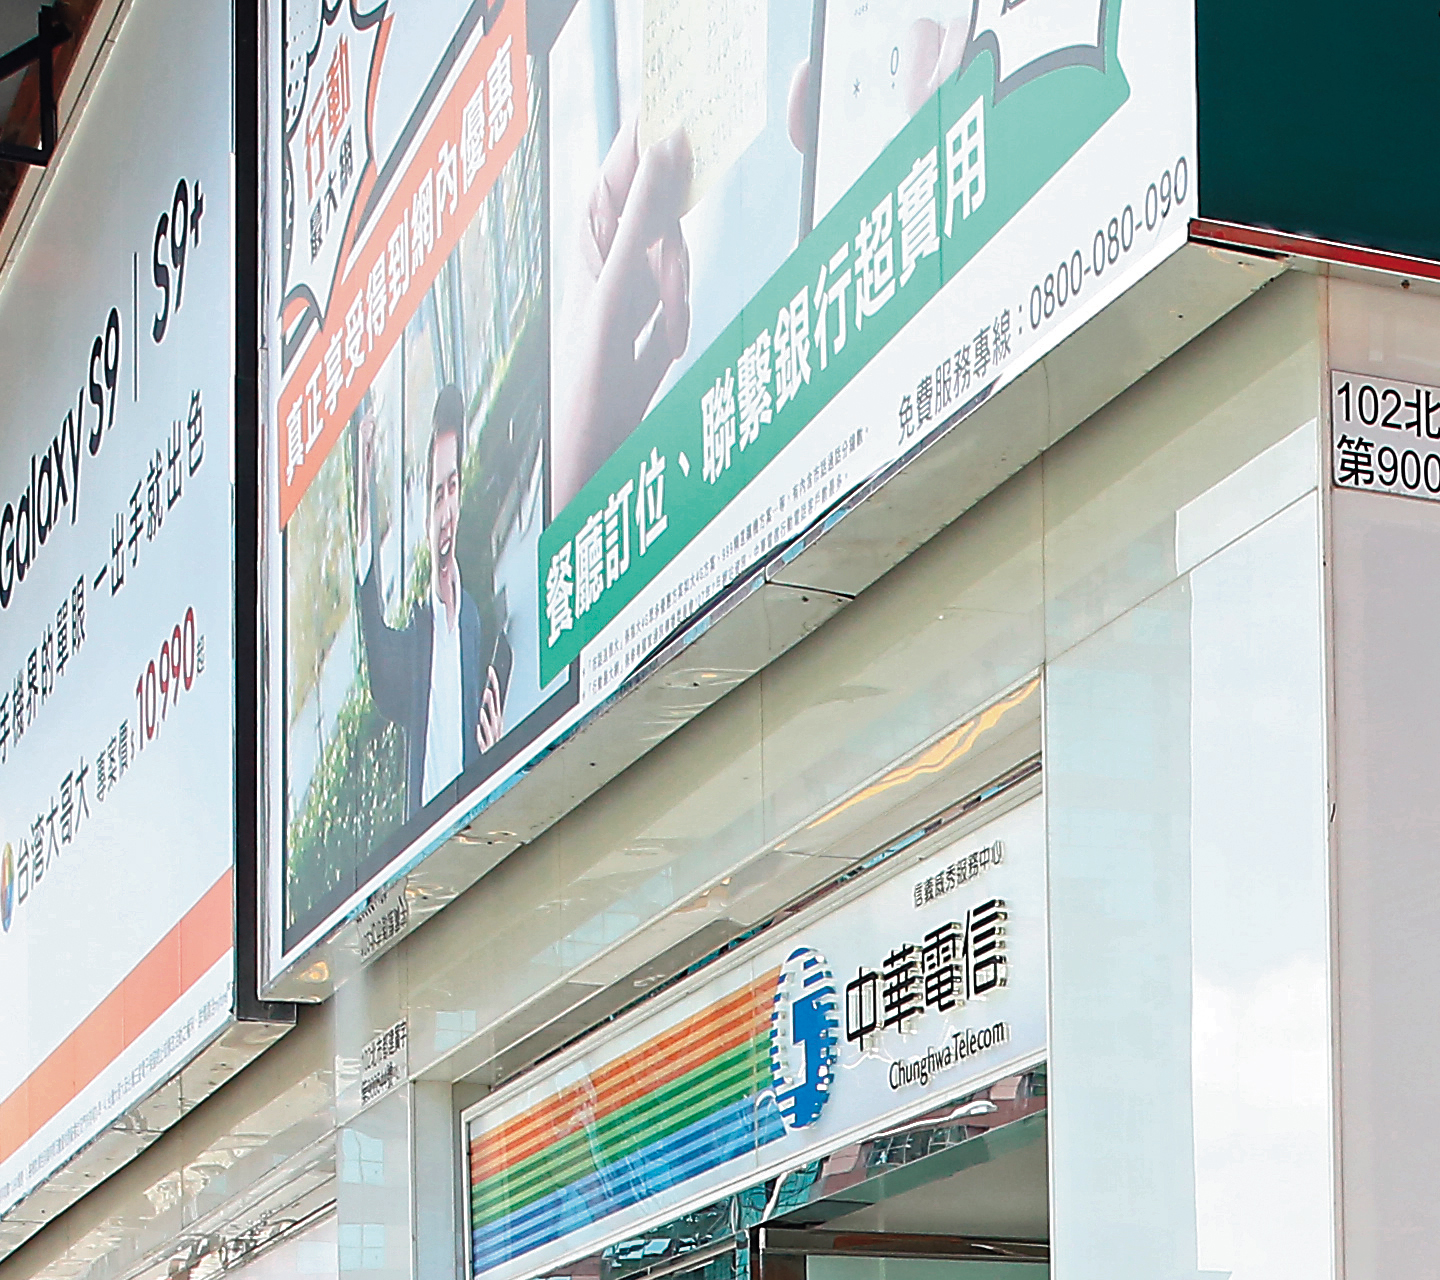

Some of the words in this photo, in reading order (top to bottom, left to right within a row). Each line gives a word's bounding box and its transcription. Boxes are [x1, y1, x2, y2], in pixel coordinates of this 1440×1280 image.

[89, 306, 120, 457] S9
[152, 177, 205, 344] S9+
[285, 34, 514, 485] 真正享受得到網內優惠
[544, 95, 989, 649] 餐廳訂位、聯繫銀行超實用
[845, 899, 1009, 1053] 中華電信
[888, 1046, 952, 1091] Chunghwa
[952, 1021, 1008, 1063] Telecom
